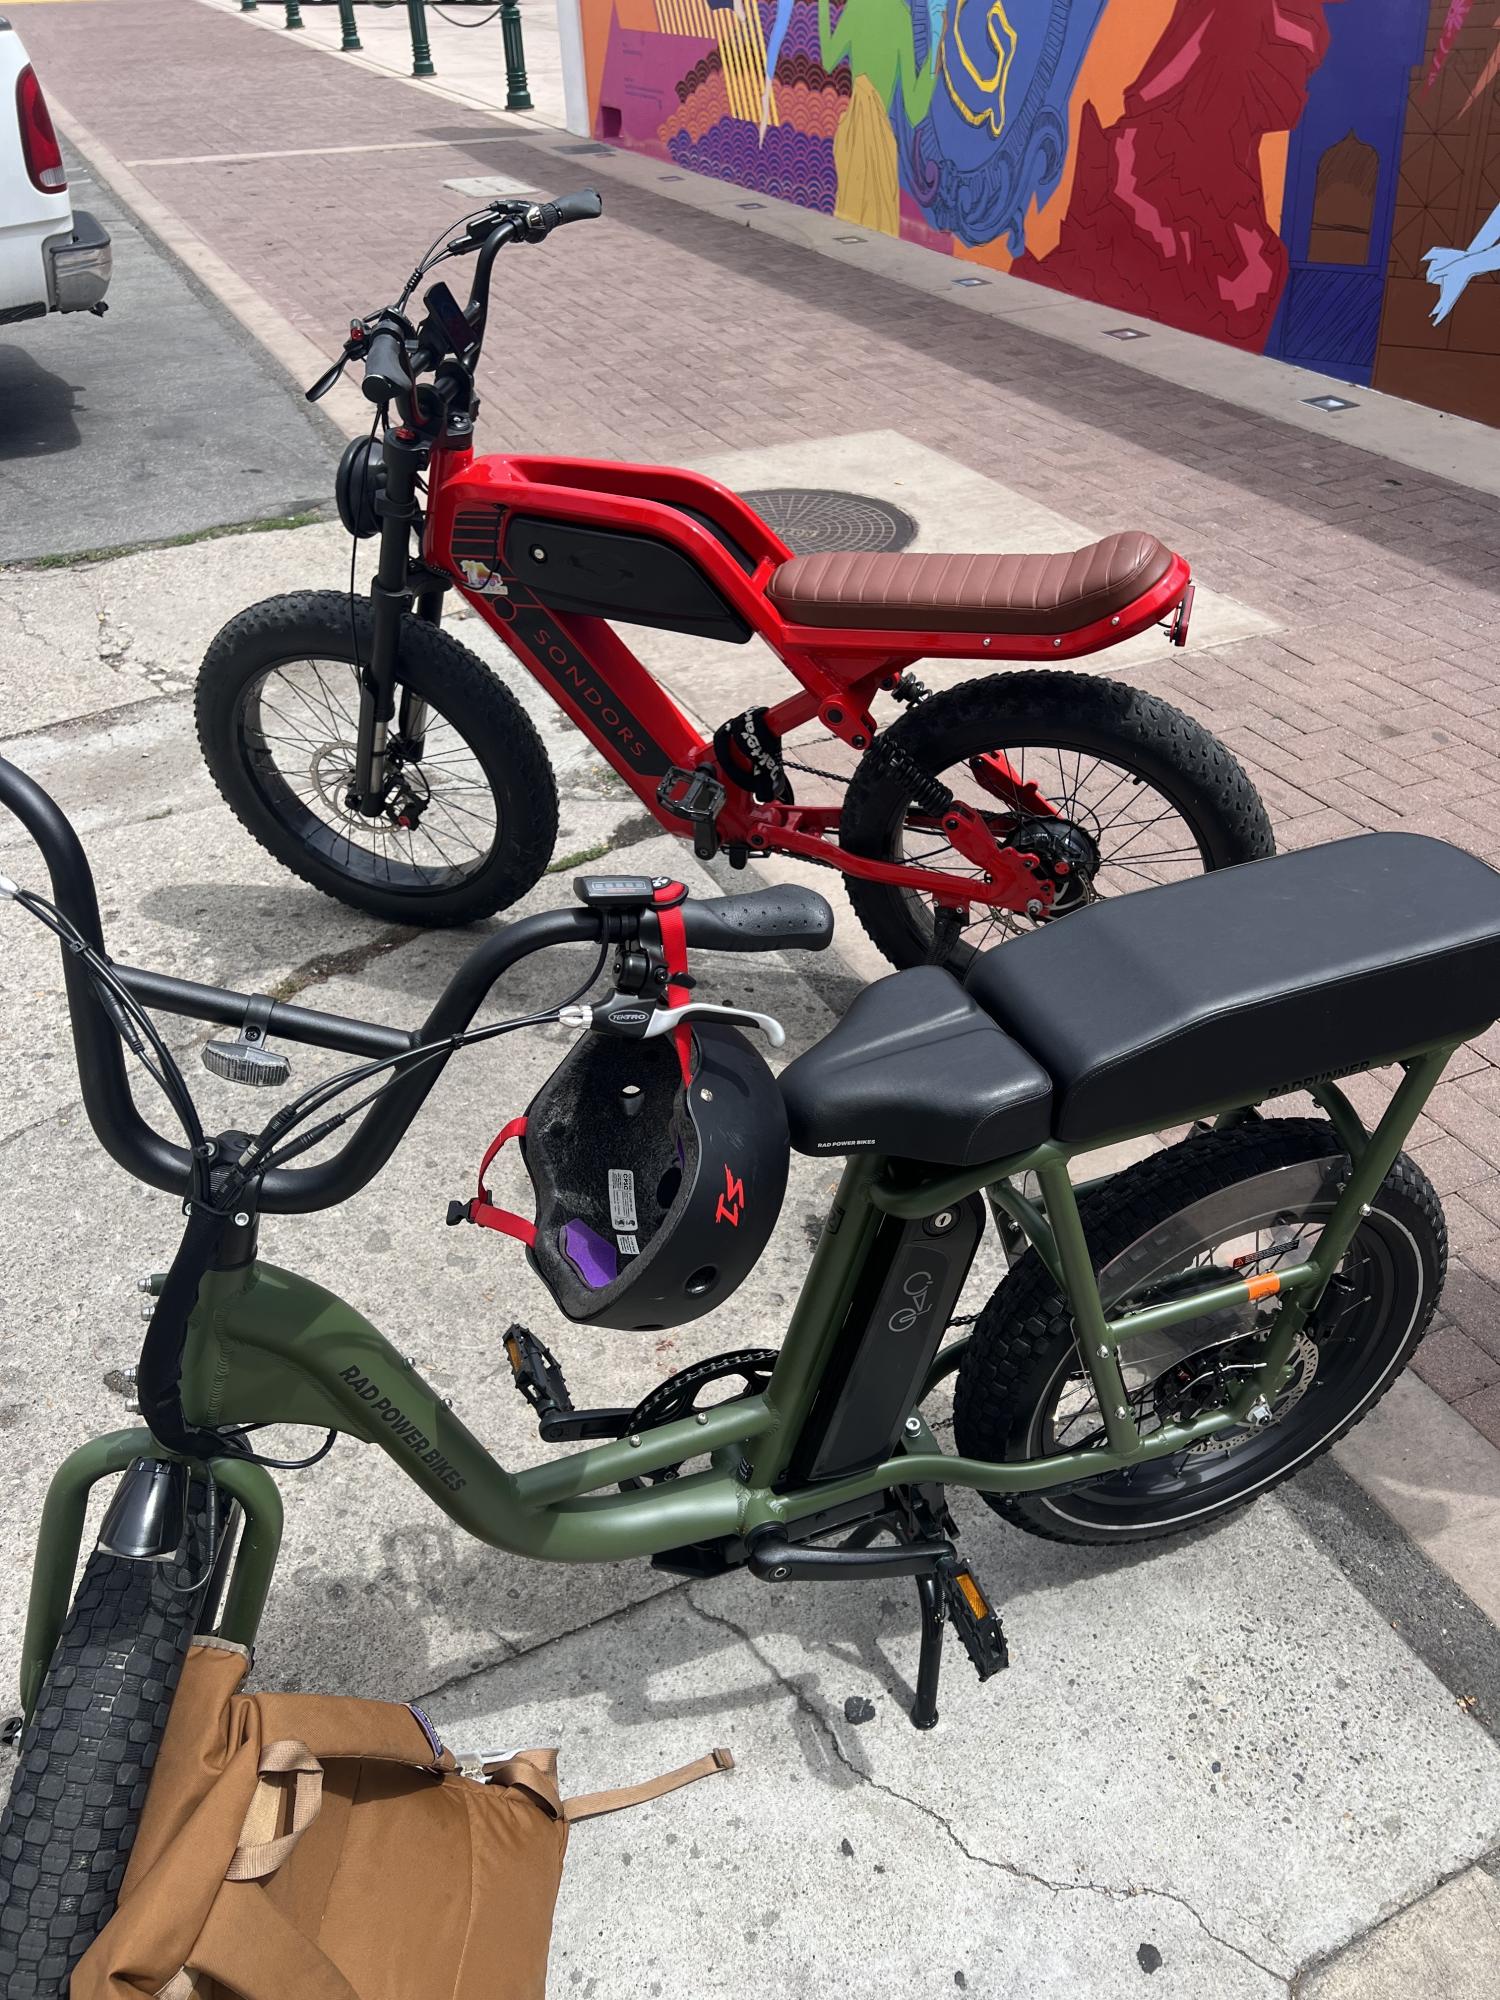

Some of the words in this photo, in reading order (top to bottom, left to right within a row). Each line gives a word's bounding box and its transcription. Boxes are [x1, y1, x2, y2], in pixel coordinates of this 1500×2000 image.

[534, 629, 648, 757] SONDORS
[338, 1364, 380, 1401] RAD
[371, 1397, 430, 1454] POWER
[421, 1448, 467, 1492] BIKES
